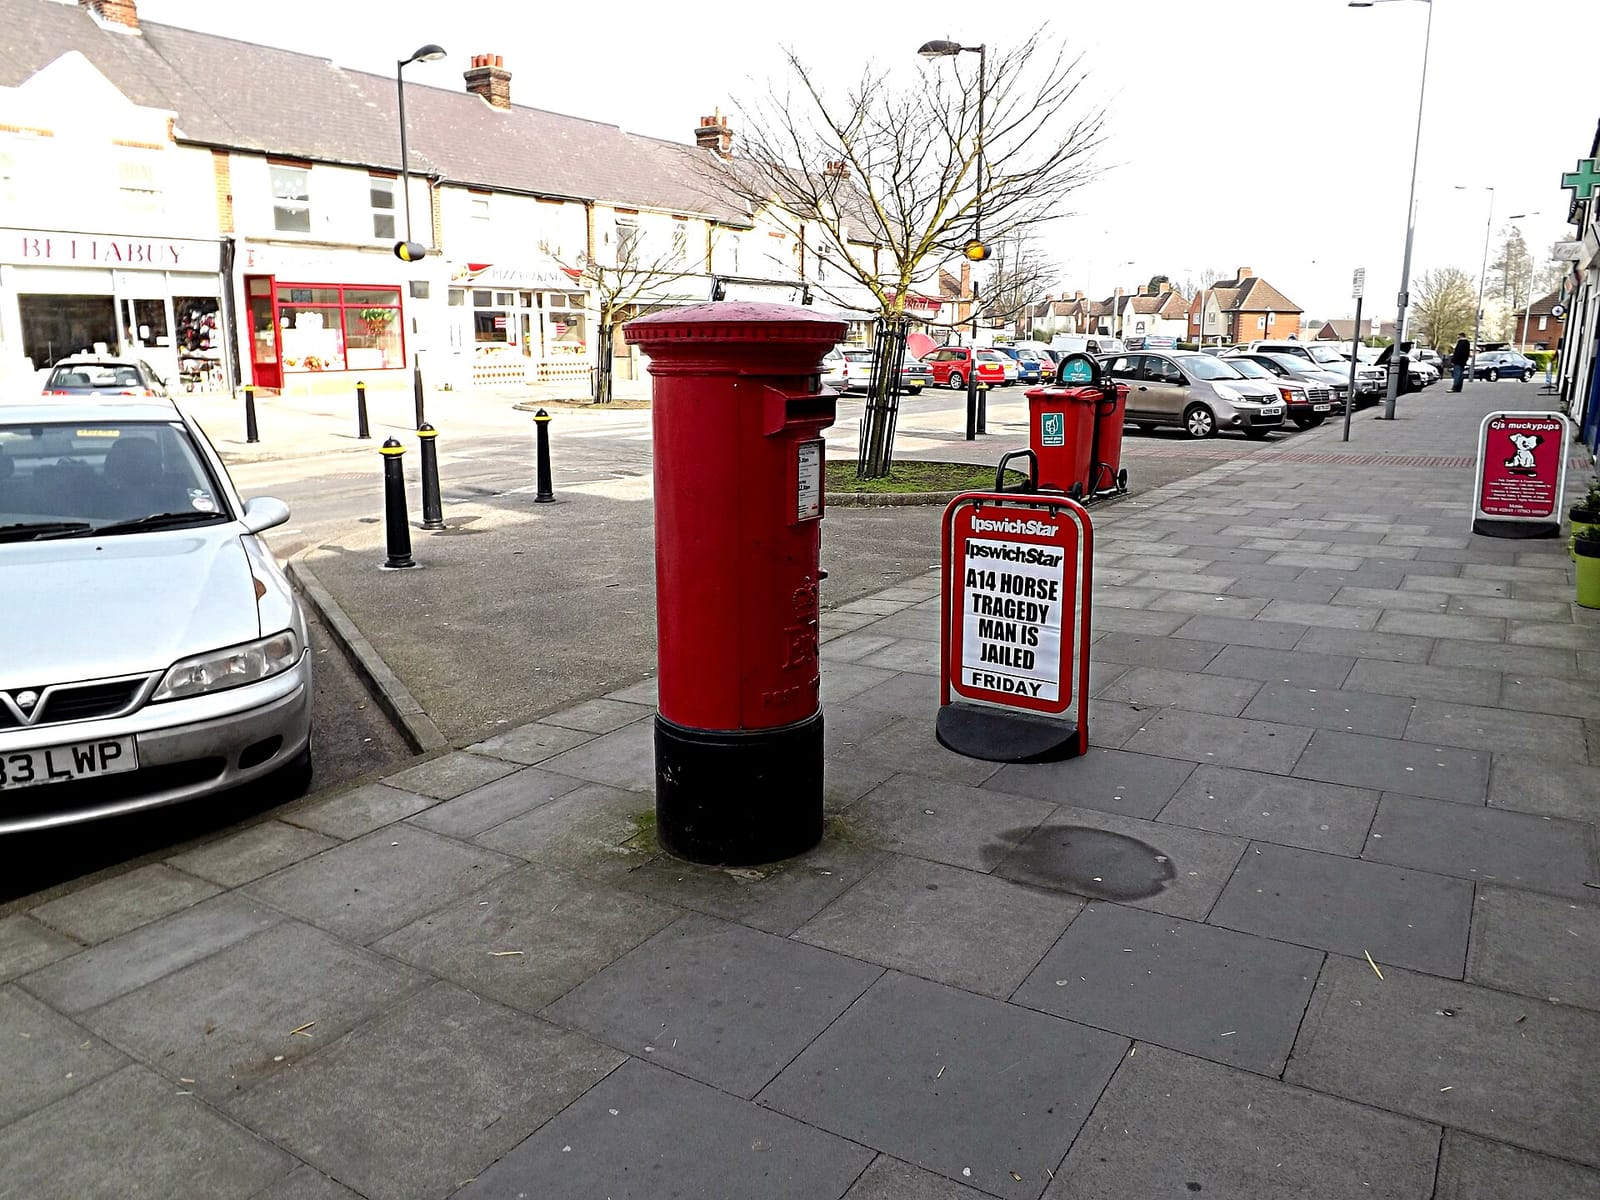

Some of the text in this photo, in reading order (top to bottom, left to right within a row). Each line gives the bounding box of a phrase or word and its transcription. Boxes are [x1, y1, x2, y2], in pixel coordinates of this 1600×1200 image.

[1508, 422, 1560, 431] muckypups
[966, 568, 1059, 601] A14 HORSE
[972, 593, 1050, 624] TRAGEDY
[978, 618, 1039, 647] MAN IS
[980, 642, 1035, 670] JAILED
[972, 672, 1042, 697] FRIDAY
[0, 741, 122, 786] 3 LWP
